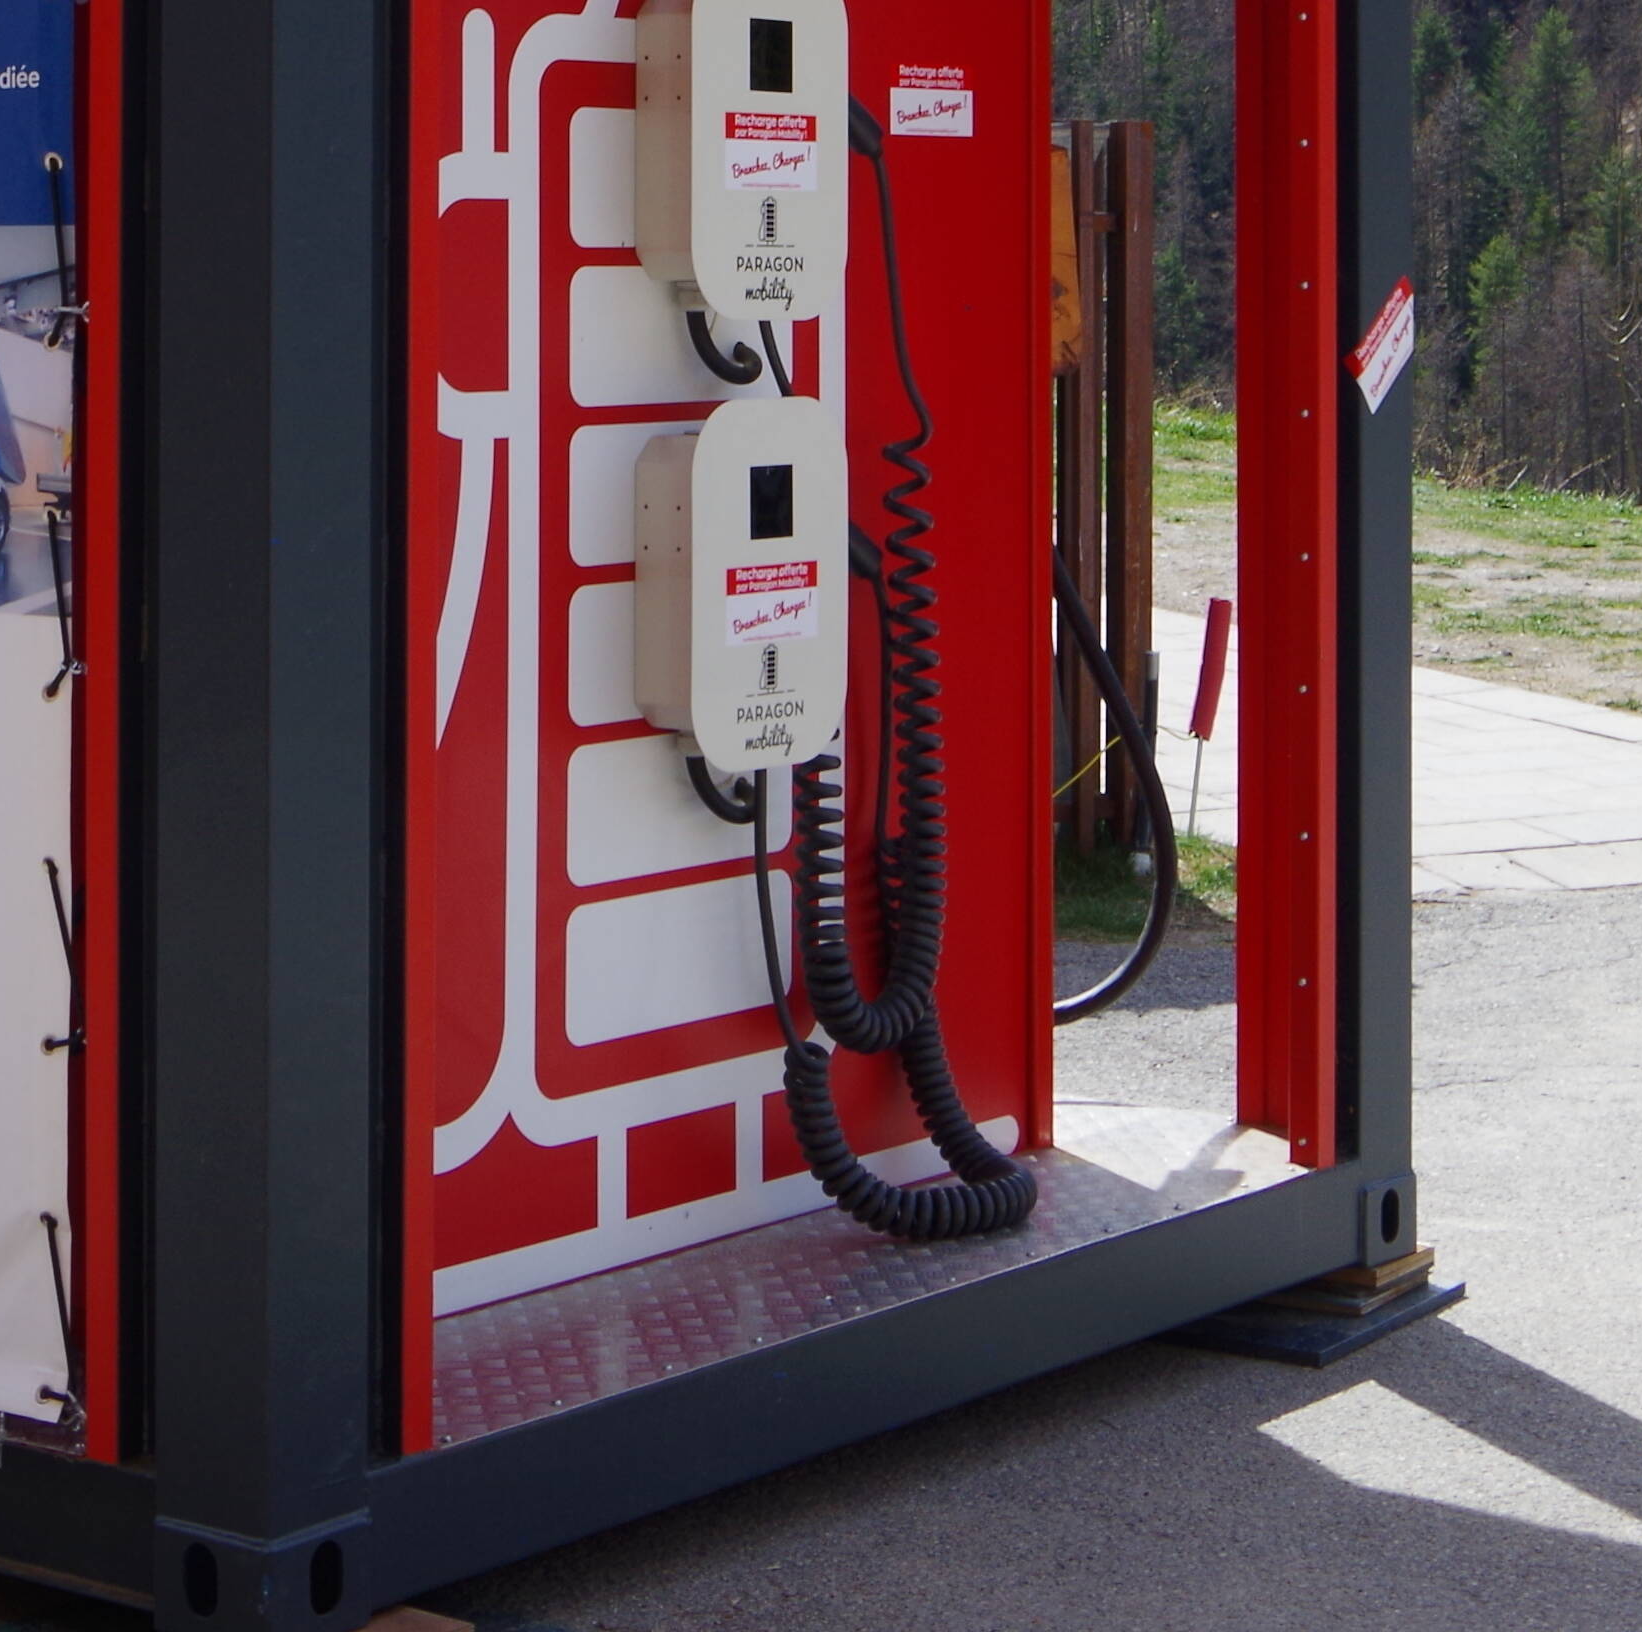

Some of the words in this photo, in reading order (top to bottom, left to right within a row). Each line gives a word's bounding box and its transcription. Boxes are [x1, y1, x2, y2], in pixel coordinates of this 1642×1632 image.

[899, 64, 936, 80] Recharge
[937, 66, 964, 79] offerte
[734, 113, 777, 129] Recharge
[777, 115, 807, 128] offerte
[737, 256, 803, 272] PARAGON
[745, 276, 793, 311] mobility
[736, 568, 778, 581] Recharge
[778, 564, 808, 578] offerte
[737, 701, 804, 723] PARAGON
[745, 723, 794, 757] mobility
